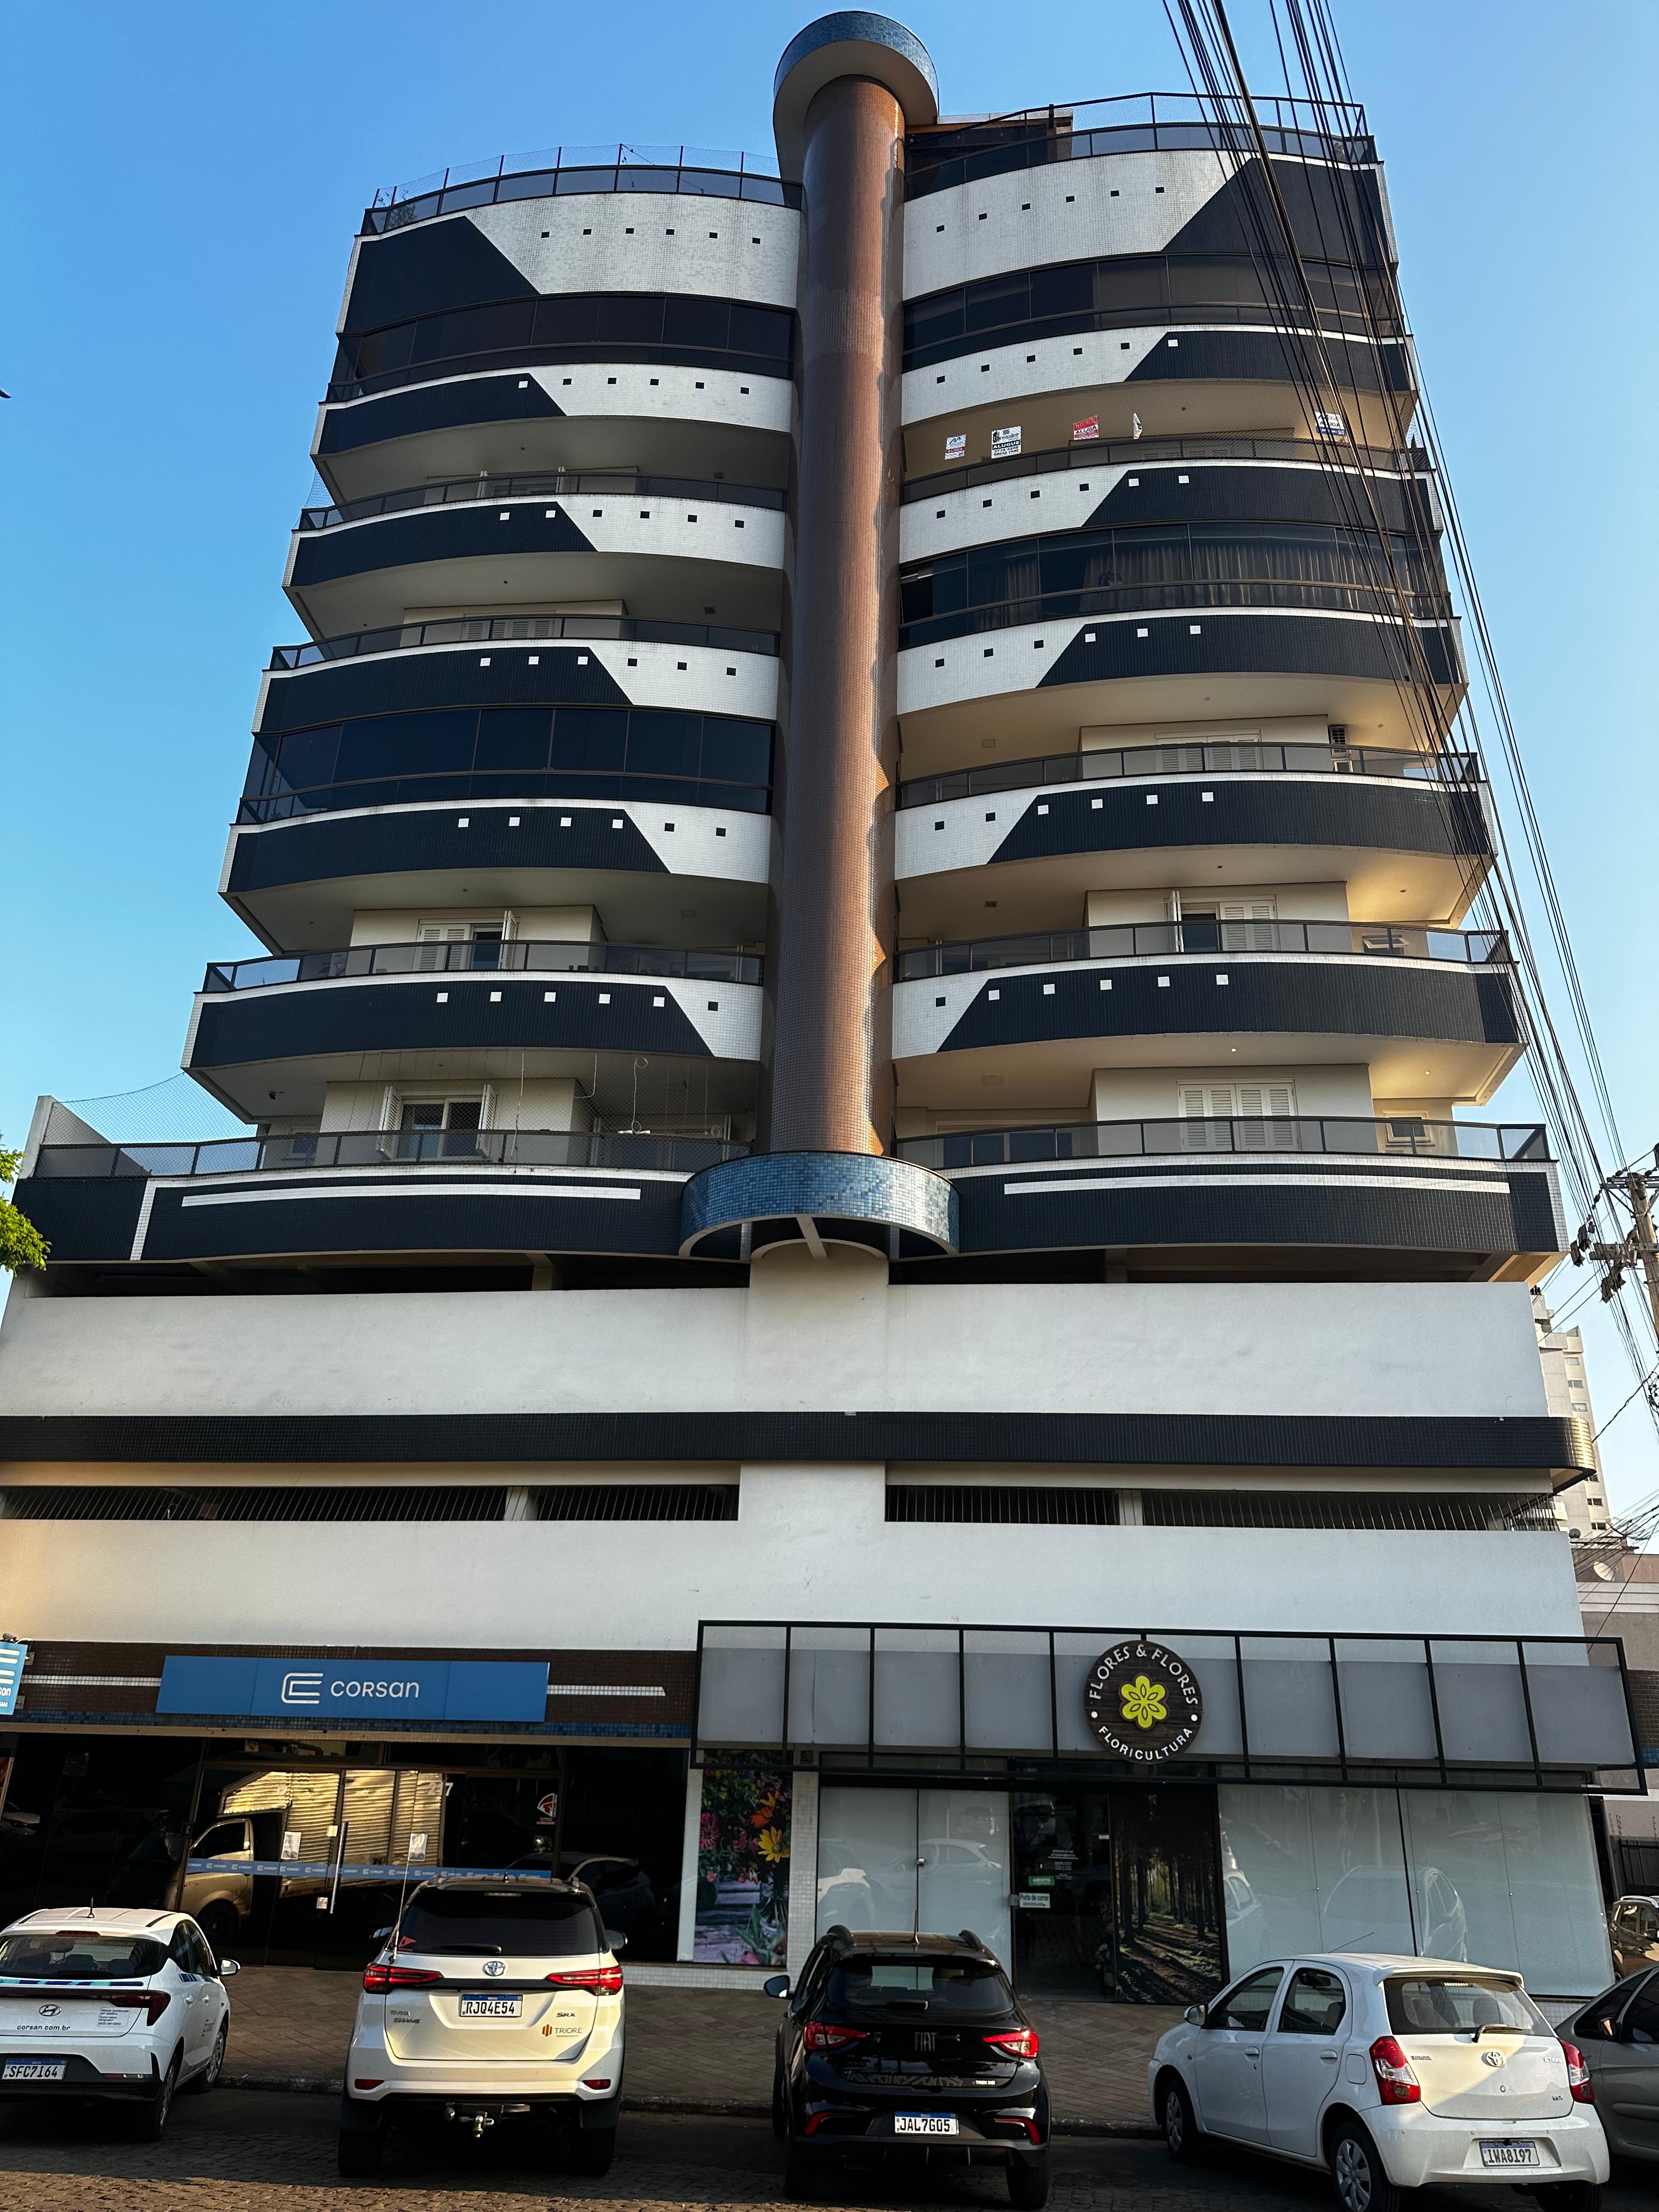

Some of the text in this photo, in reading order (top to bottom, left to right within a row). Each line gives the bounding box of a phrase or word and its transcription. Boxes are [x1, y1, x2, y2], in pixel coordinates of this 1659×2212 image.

[1076, 426, 1096, 434] ALUGA
[993, 441, 1020, 449] ALUGUE
[1090, 1644, 1198, 1705] FLORES & FLORES
[1098, 1726, 1193, 1760] FLORICULTURA
[466, 2001, 515, 2014] RJQ4E54
[914, 2032, 937, 2052] FIAT
[9, 2066, 58, 2078] SFC7I64
[900, 2118, 950, 2132] JAL7G05
